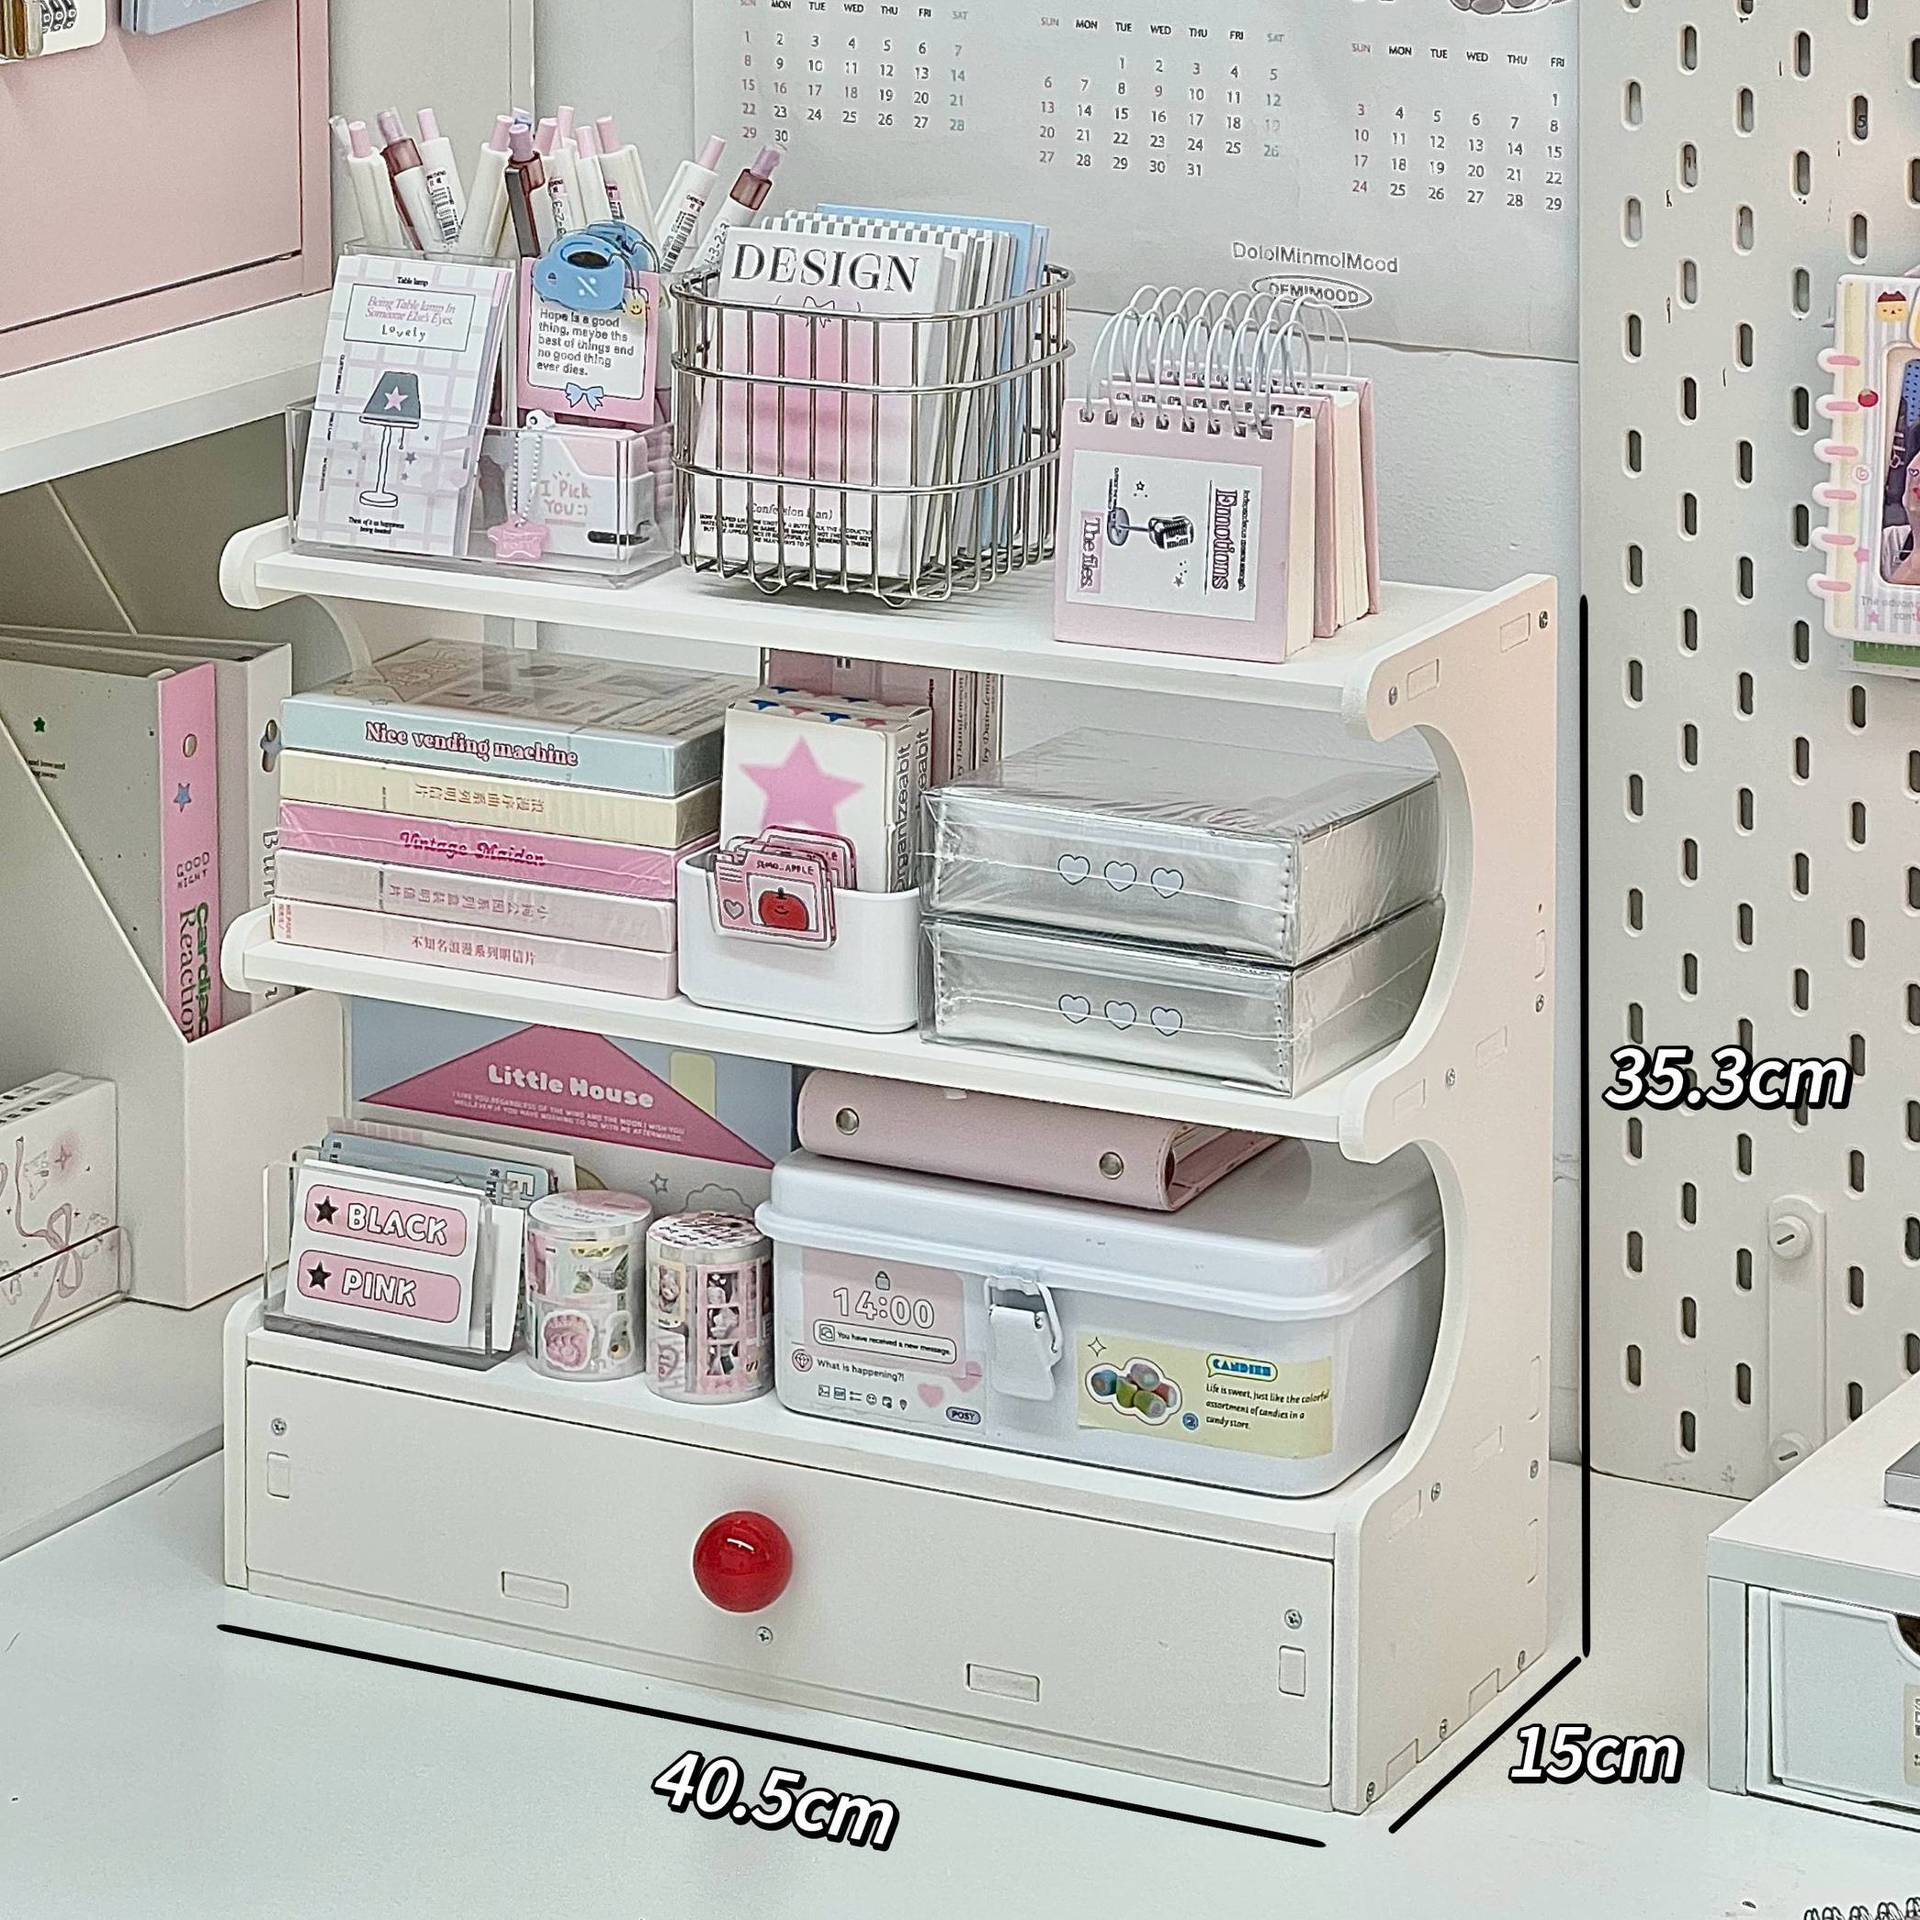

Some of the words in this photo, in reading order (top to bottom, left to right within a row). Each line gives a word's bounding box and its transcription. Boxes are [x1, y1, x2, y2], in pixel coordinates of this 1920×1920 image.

[771, 0, 792, 9] MON
[808, 1, 826, 11] TUE
[843, 3, 865, 13] WED
[880, 5, 899, 16] THU
[918, 7, 932, 18] FRI
[1040, 16, 1060, 27] SUN
[1075, 19, 1098, 30] MON
[1115, 21, 1132, 33] TUE
[1150, 24, 1172, 35] WED
[1188, 27, 1208, 38] THU
[1229, 30, 1244, 41] FRI
[1351, 42, 1371, 54] SUN
[1388, 46, 1412, 56] MON
[1430, 48, 1448, 59] TUE
[1466, 51, 1489, 62] WED
[1506, 54, 1528, 65] THU
[1550, 57, 1565, 68] FRI
[741, 78, 756, 91] 15
[773, 81, 788, 94] 16
[808, 84, 822, 97] 17
[844, 85, 858, 99] 18
[879, 88, 894, 102] 19
[913, 91, 929, 105] 20
[949, 93, 964, 107] 21
[1041, 100, 1055, 114] 13
[1077, 104, 1092, 117] 14
[1115, 107, 1129, 120] 15
[1151, 110, 1167, 123] 16
[1189, 112, 1204, 127] 17
[1226, 116, 1241, 130] 18
[1039, 125, 1055, 139] 20
[1076, 128, 1090, 142] 21
[1112, 131, 1129, 145] 22
[1150, 134, 1165, 149] 23
[1187, 137, 1204, 152] 24
[1225, 141, 1241, 155] 25
[1039, 150, 1055, 164] 27
[1076, 153, 1091, 167] 28
[1112, 156, 1128, 170] 29
[1149, 159, 1166, 174] 30
[1187, 162, 1202, 177] 31
[1352, 179, 1368, 193] 24
[1390, 183, 1406, 197] 25
[1428, 186, 1445, 200] 26
[1467, 189, 1485, 204] 27
[1506, 193, 1524, 208] 28
[1545, 197, 1563, 211] 29
[732, 243, 919, 293] DESIGN
[396, 299, 419, 310] Table
[539, 322, 569, 336] thing,
[573, 328, 608, 340] maybe
[540, 309, 568, 322] Hope
[571, 312, 579, 322] is
[583, 316, 589, 324] a
[592, 316, 619, 328] good
[382, 324, 425, 342] Lovely
[539, 335, 561, 346] best
[564, 337, 575, 348] of
[578, 339, 610, 354] things
[614, 345, 634, 356] and
[537, 362, 559, 371] ever
[563, 364, 588, 375] dies.
[538, 349, 550, 357] no
[554, 351, 581, 362] good
[584, 355, 611, 368] thing
[540, 480, 549, 496] I
[559, 481, 591, 498] Pick
[1083, 518, 1100, 551] The
[1212, 489, 1238, 590] Emotions
[365, 722, 408, 745] Nice
[413, 732, 490, 762] vending
[494, 741, 579, 767] machine
[400, 831, 468, 859] Vintage
[476, 842, 546, 866] Maiden
[176, 852, 210, 877] GOOD
[412, 935, 536, 965] 不知名浪漫系列明信片
[488, 1063, 563, 1092] Little
[569, 1077, 654, 1108] House
[347, 1202, 448, 1246] BLACK
[342, 1269, 417, 1307] PINK
[834, 1287, 934, 1329] 14:00
[838, 1332, 850, 1340] You
[852, 1334, 867, 1342] have
[869, 1337, 897, 1347] received
[817, 1359, 840, 1370] What
[852, 1366, 904, 1382] happening?!
[1206, 1384, 1219, 1392] Life
[1228, 1388, 1252, 1399] sweet,
[1253, 1392, 1268, 1400] just
[1270, 1393, 1284, 1402] like
[1286, 1395, 1300, 1403] the
[1301, 1390, 1330, 1403] colorful
[1206, 1401, 1248, 1413] assortment
[1250, 1407, 1259, 1416] of
[1260, 1410, 1288, 1418] candies
[1290, 1411, 1297, 1419] in
[1206, 1416, 1229, 1427] candy
